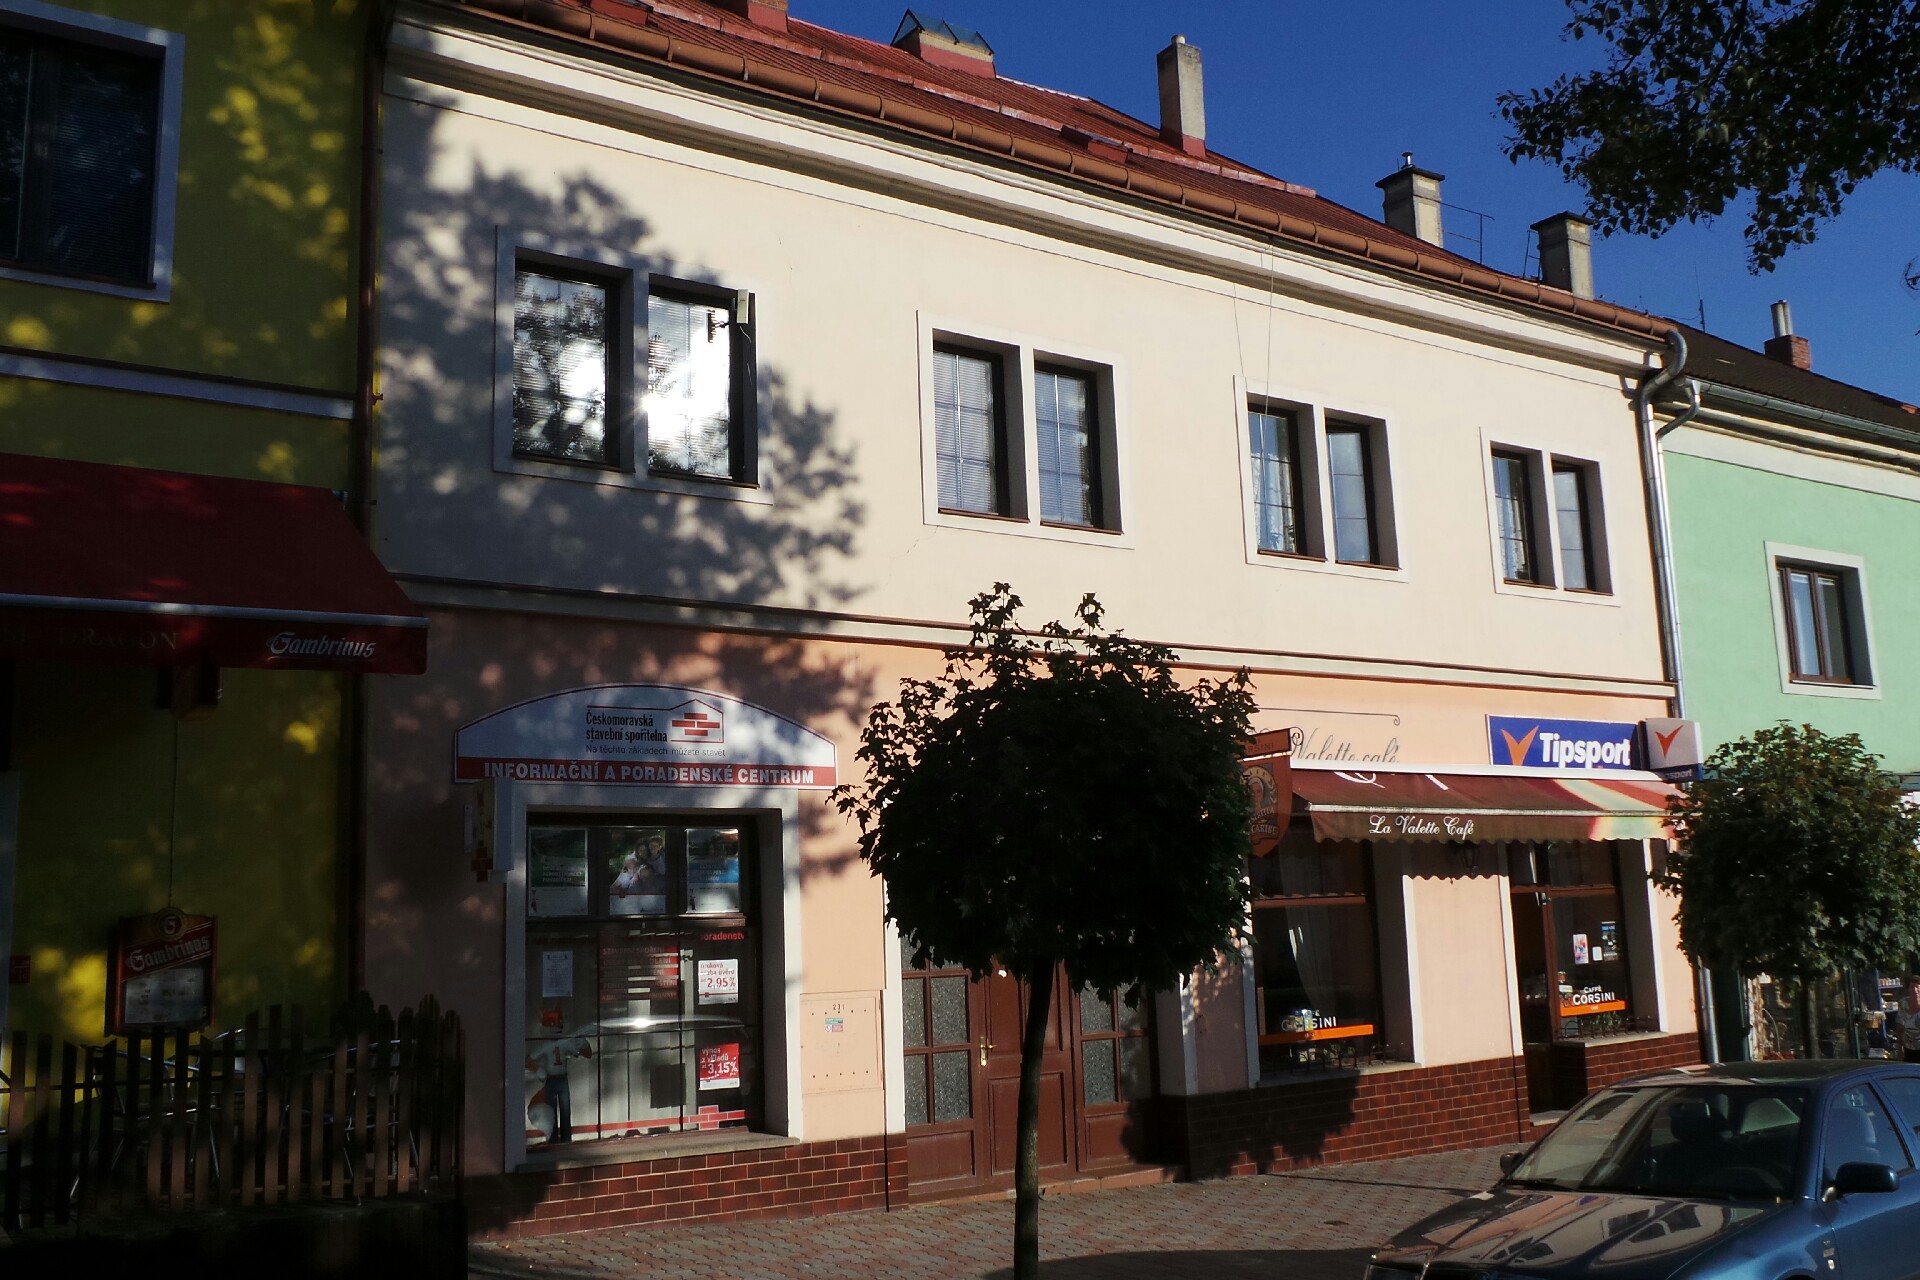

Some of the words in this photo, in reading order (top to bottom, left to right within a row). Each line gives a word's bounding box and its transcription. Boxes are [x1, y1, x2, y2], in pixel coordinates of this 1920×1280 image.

[265, 631, 377, 658] Gambrinus
[586, 711, 654, 727] Českomoravská
[586, 728, 623, 741] stavební
[625, 729, 667, 743] spořitelna
[586, 744, 598, 753] Na
[600, 745, 626, 754] těchto
[628, 746, 668, 755] základech
[671, 747, 700, 756] můžete
[702, 747, 726, 757] stavět
[1540, 732, 1631, 769] Tipsport
[484, 761, 600, 779] INFORMAČNÍ
[605, 765, 616, 779] A
[621, 765, 734, 782] PORADENSKÉ
[737, 768, 814, 784] CENTRUM
[1369, 815, 1391, 834] La
[1395, 815, 1440, 835] Valette
[1443, 816, 1474, 840] Café
[126, 935, 211, 971] Gambrinus
[1572, 992, 1615, 1005] CORSINI
